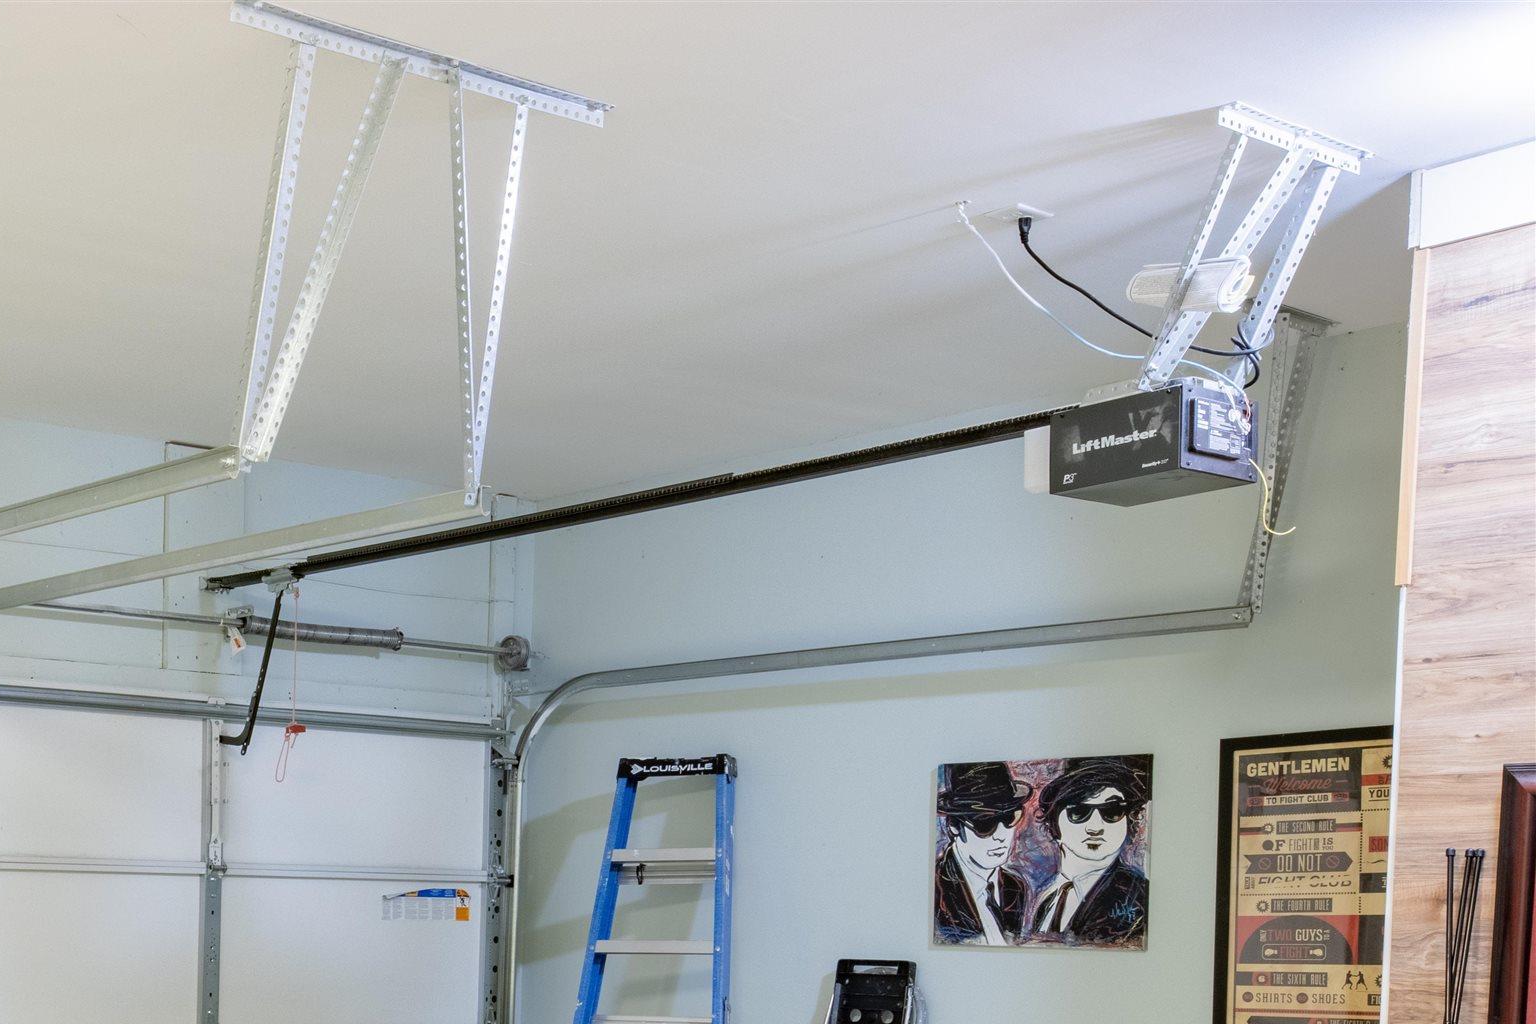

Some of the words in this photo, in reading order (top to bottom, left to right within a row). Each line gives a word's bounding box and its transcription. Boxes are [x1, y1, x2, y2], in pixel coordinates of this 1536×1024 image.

[1072, 428, 1157, 455] LiftMaster
[643, 762, 714, 773] LOUISVILLE
[1246, 757, 1350, 777] GENTLEMEN
[1263, 777, 1332, 795] Welcome
[1266, 797, 1277, 805] TO
[1280, 795, 1304, 804] FIGHT
[1307, 794, 1329, 803] CLUB
[1278, 822, 1289, 833] THE
[1292, 820, 1316, 832] SECOND
[1319, 820, 1334, 831] RULE
[1288, 838, 1312, 851] FIGHT
[1322, 837, 1334, 845] IS
[1297, 853, 1323, 872] NOT
[1273, 899, 1284, 911] THE
[1287, 899, 1310, 911] FOURTH
[1315, 899, 1330, 911] RULE
[1295, 929, 1323, 941] GUYS
[1273, 973, 1284, 985] THE
[1287, 974, 1307, 985] SIXTH
[1310, 974, 1326, 986] RULE
[1255, 993, 1293, 1003] SHIRTS
[1312, 993, 1346, 1004] SHOES
